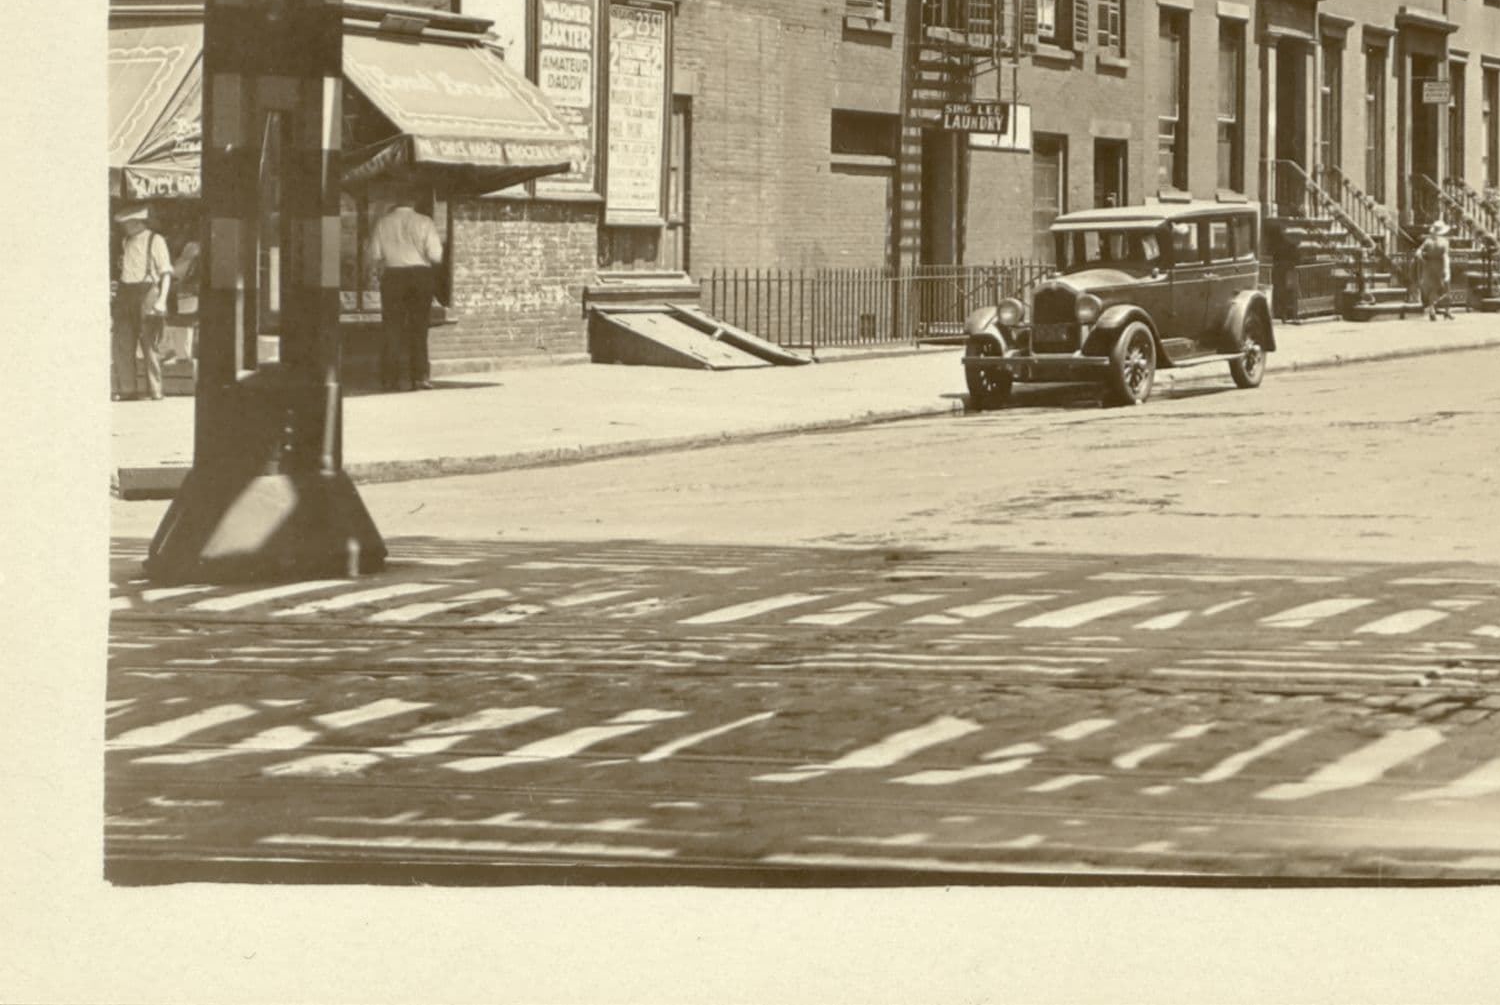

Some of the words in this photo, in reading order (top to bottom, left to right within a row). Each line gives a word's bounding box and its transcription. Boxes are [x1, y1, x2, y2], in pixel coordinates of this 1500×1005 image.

[542, 0, 592, 24] WARNER
[636, 11, 650, 36] 23
[541, 19, 592, 51] BAXTER
[542, 54, 589, 74] AMATEUR
[547, 73, 583, 91] DADDY
[944, 103, 972, 114] SING
[943, 114, 1003, 132] LAUNDRY
